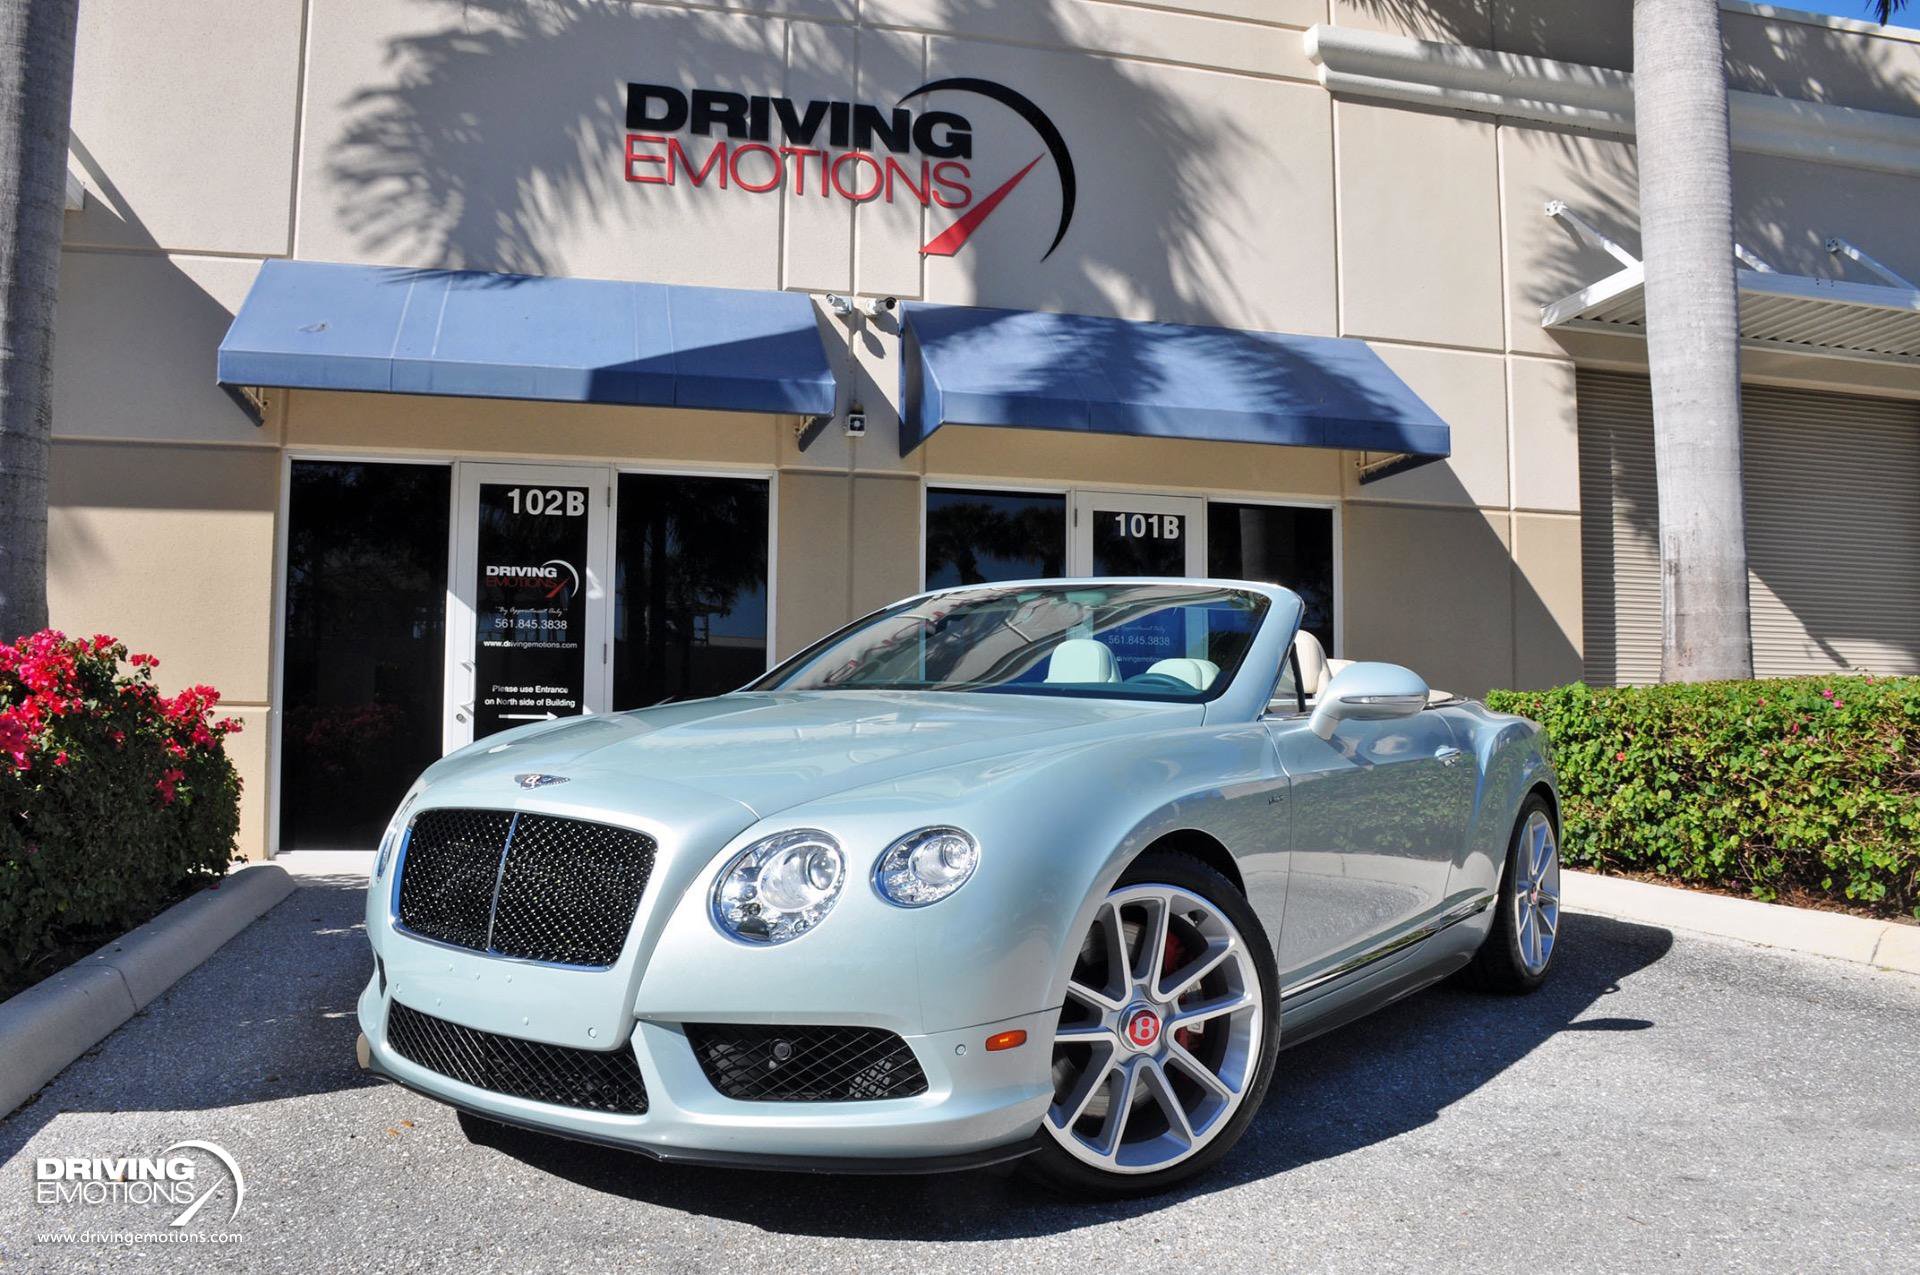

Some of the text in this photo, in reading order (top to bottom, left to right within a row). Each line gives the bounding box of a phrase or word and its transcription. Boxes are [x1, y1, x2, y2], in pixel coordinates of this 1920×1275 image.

[626, 82, 973, 160] DRIVING
[624, 133, 972, 209] EMOTIONS
[507, 488, 585, 516] 102B
[1115, 513, 1179, 539] 101B
[486, 565, 557, 578] DRIVING
[485, 576, 557, 588] EMOTIONS
[495, 618, 568, 630] 561.845.3838
[483, 640, 578, 650] www.drivingemotions.com
[492, 685, 518, 693] Please
[535, 685, 568, 694] Entrance
[496, 698, 518, 706] North
[519, 698, 535, 706] side
[545, 698, 576, 708] Building
